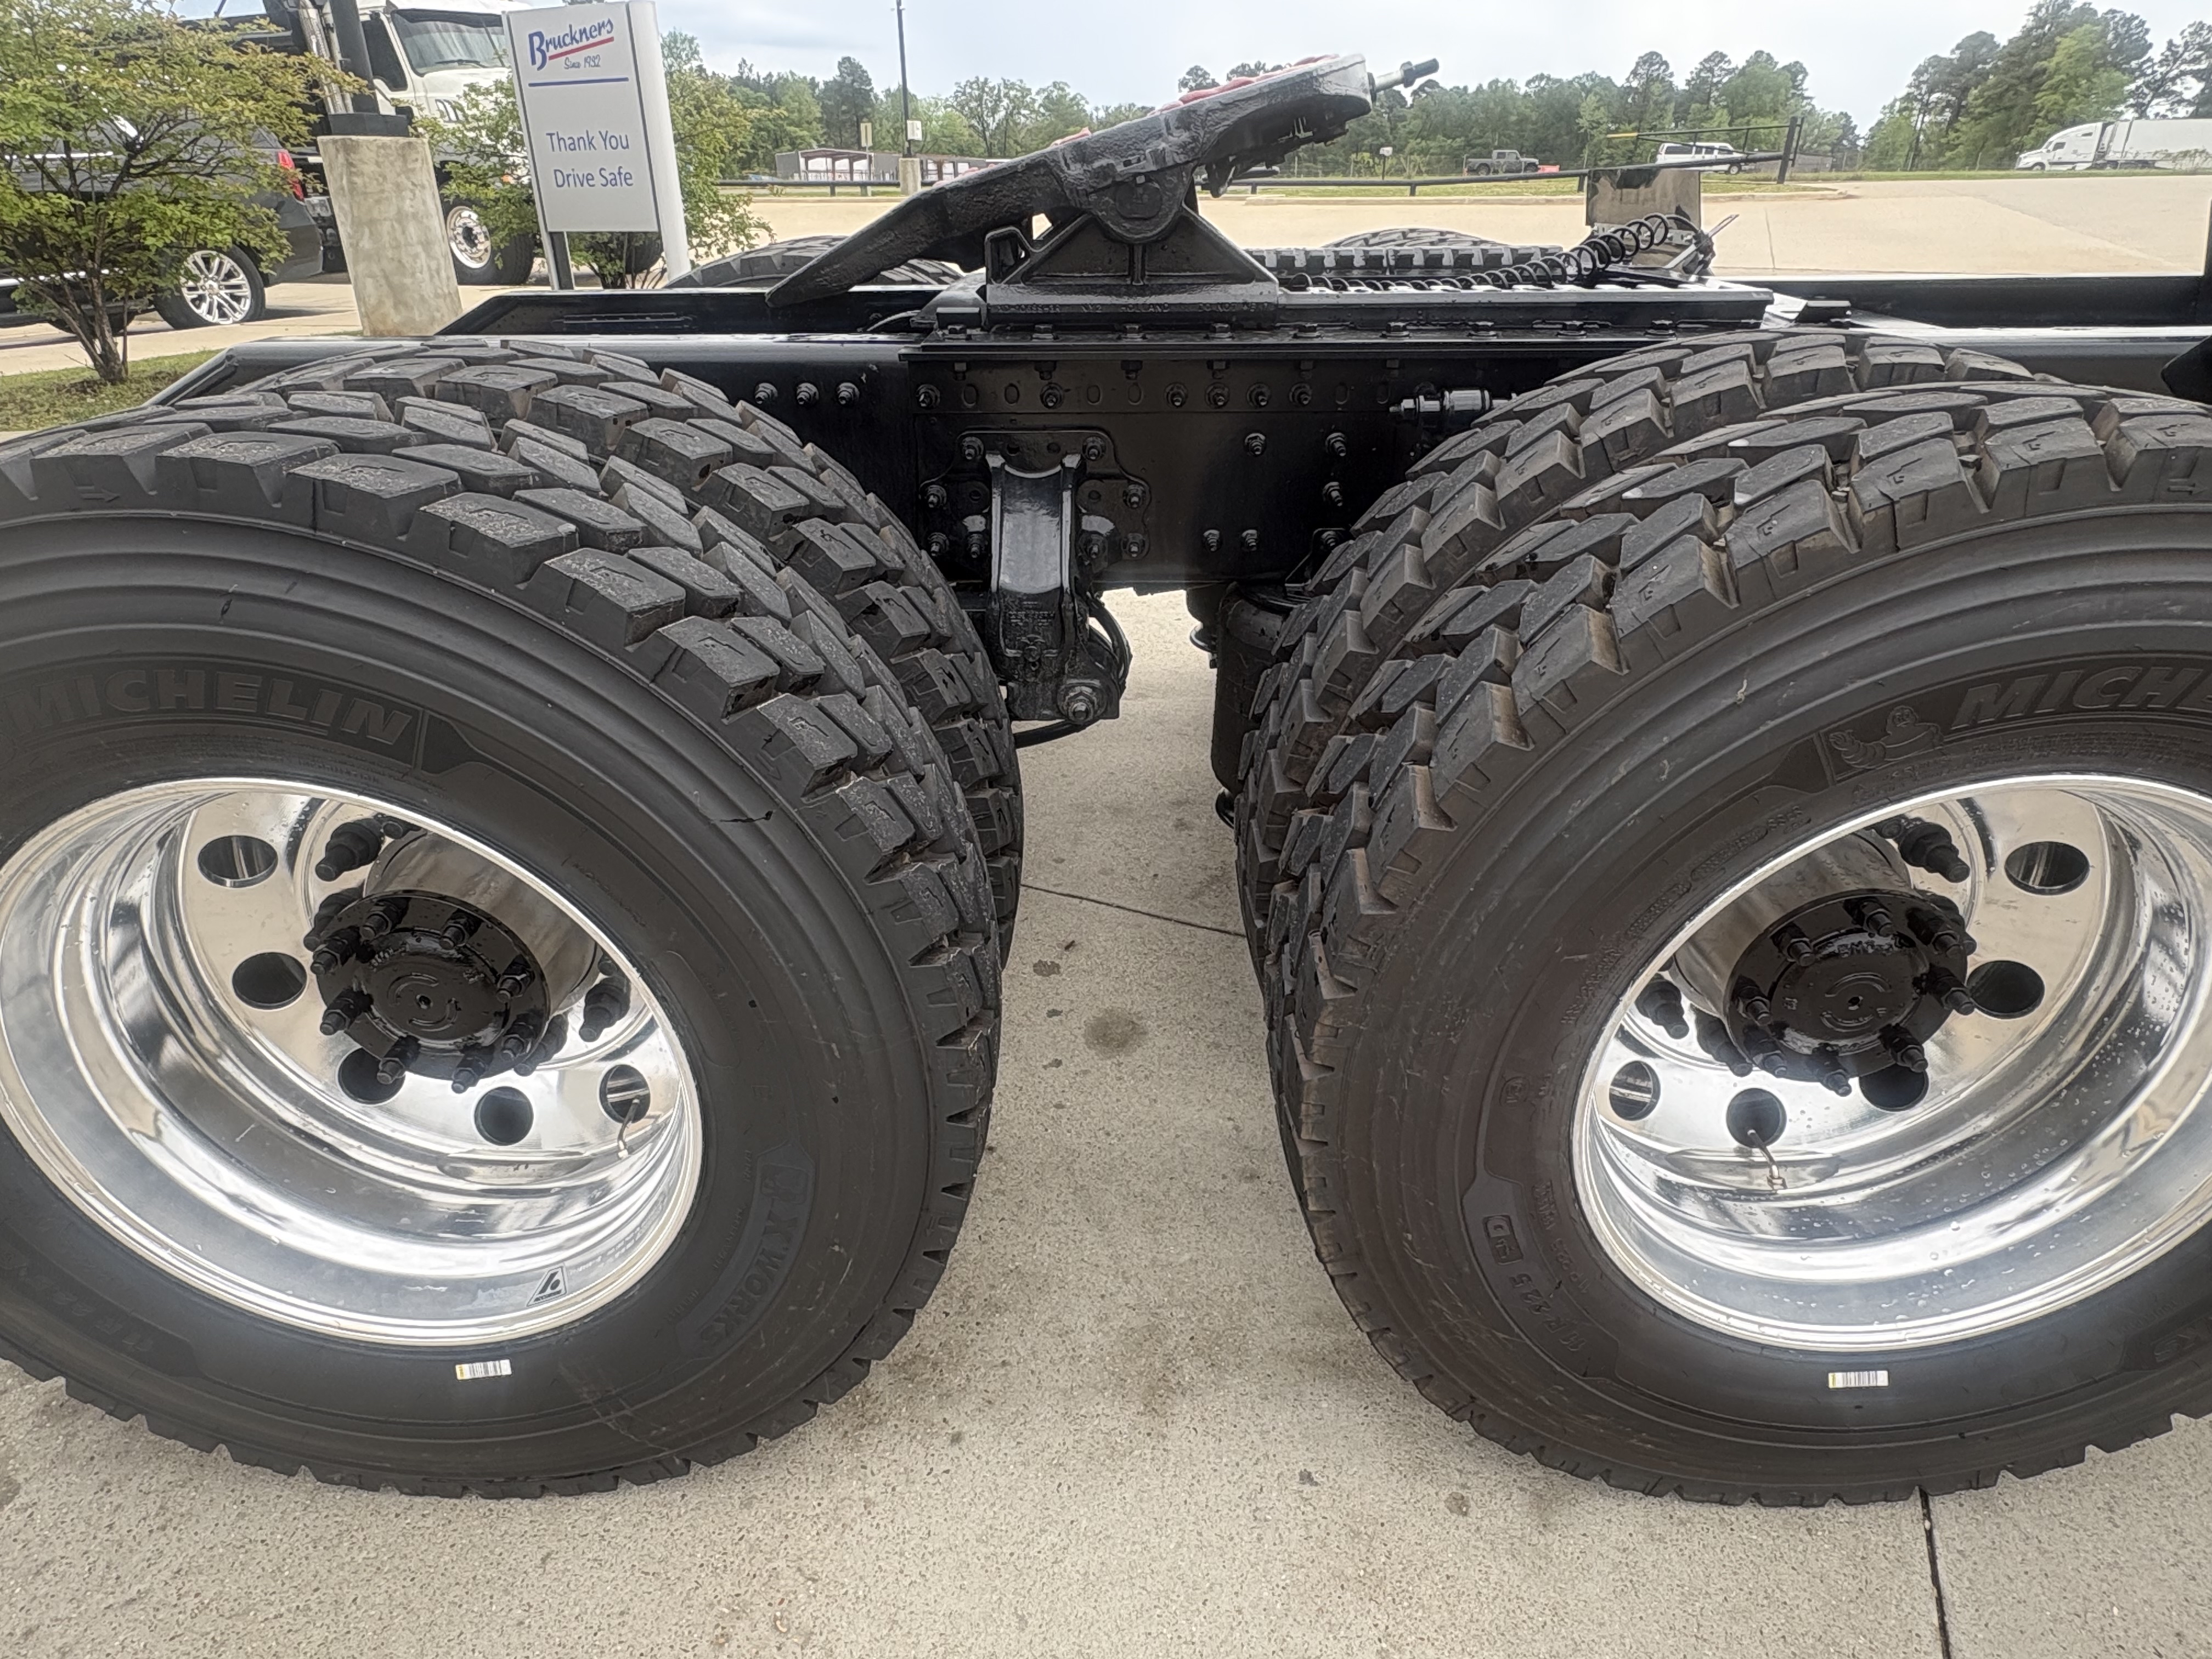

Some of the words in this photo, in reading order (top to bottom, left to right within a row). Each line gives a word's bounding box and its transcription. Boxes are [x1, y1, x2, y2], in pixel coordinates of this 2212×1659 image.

[528, 18, 614, 71] Bruckners
[563, 57, 582, 70] Since
[584, 54, 601, 68] 1932
[546, 130, 596, 153] Thank
[599, 130, 630, 150] You
[554, 169, 596, 188] Drive
[600, 166, 634, 188] Safe
[0, 669, 413, 745] MICHELIN
